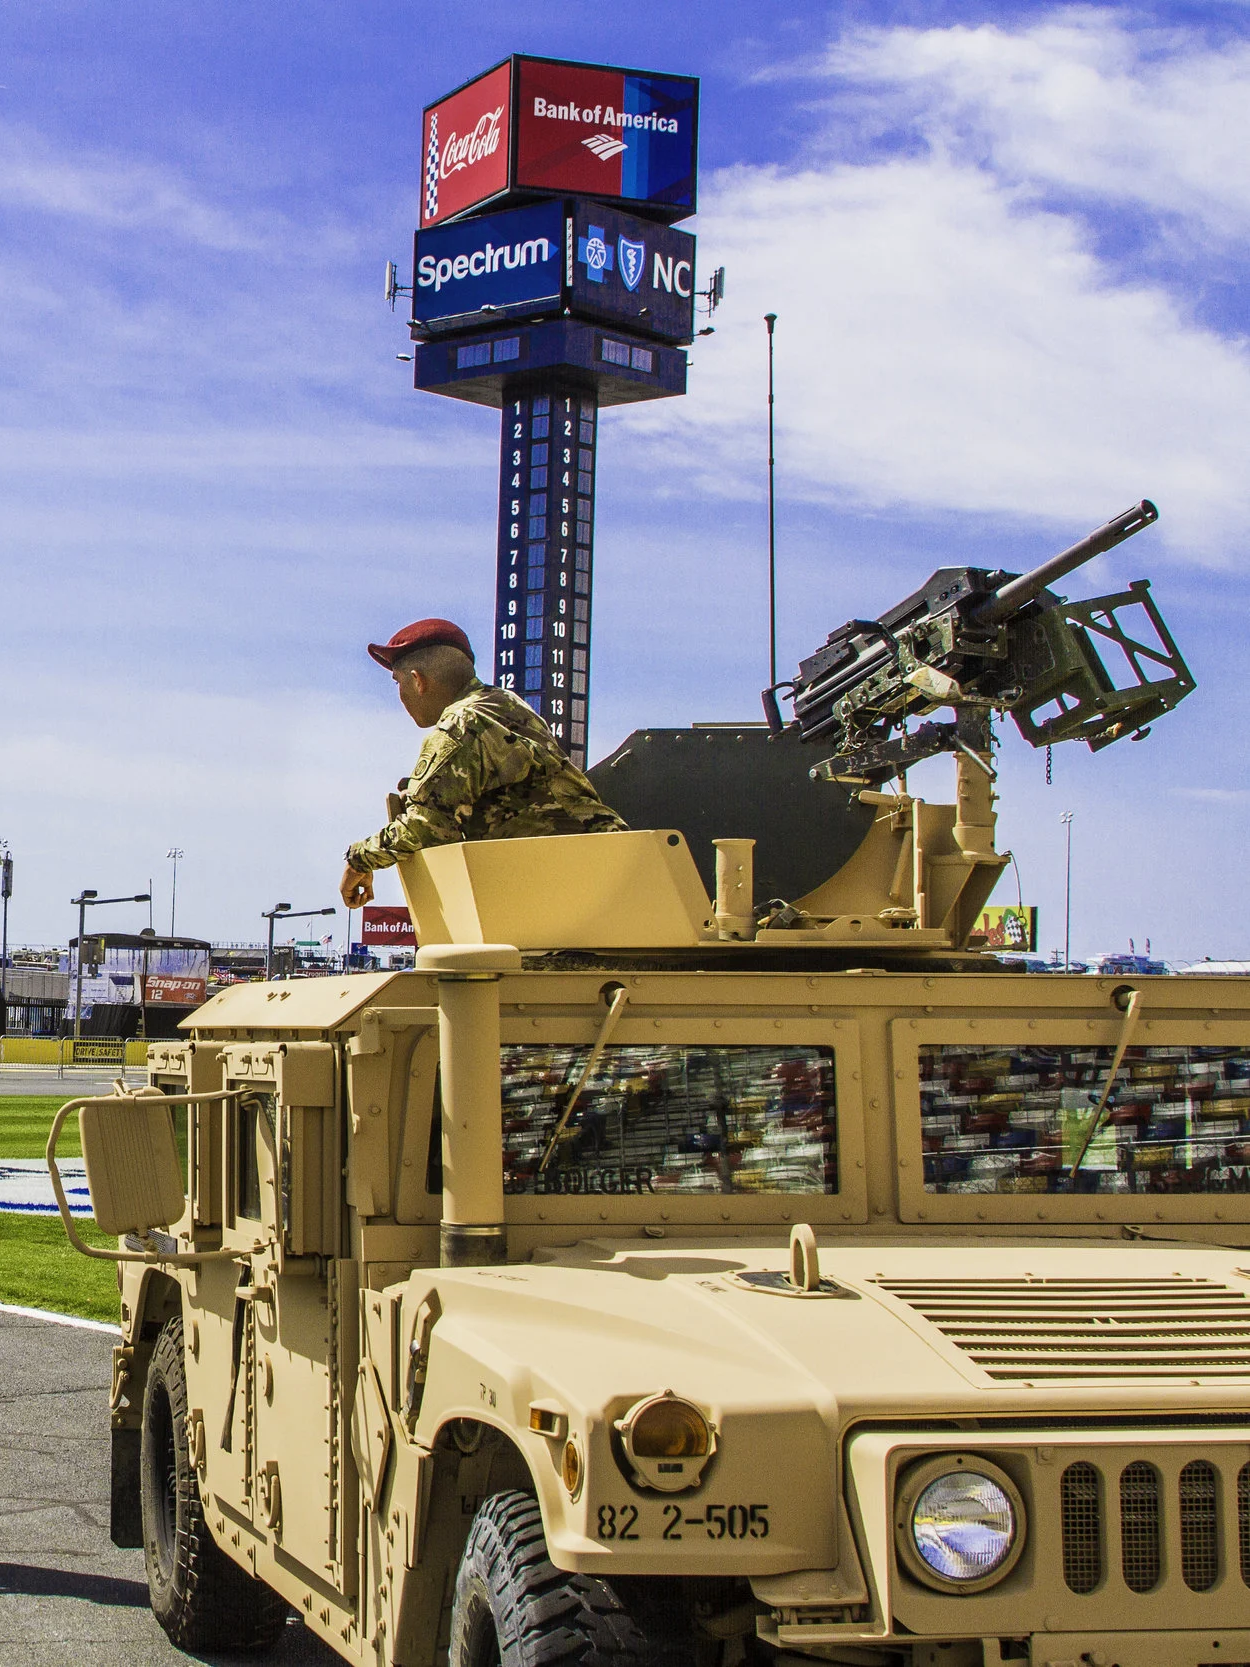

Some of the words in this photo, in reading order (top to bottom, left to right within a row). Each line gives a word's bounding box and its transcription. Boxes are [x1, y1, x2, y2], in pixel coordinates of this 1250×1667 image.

[534, 97, 579, 123] Bank
[582, 103, 601, 124] of
[603, 106, 678, 134] America
[440, 104, 505, 180] Coca-Cola
[417, 237, 549, 292] Spectrum
[652, 252, 691, 298] NC
[514, 400, 520, 415] 1
[565, 398, 570, 413] 1
[514, 423, 522, 438] 2
[564, 420, 572, 436] 2
[513, 450, 521, 466] 3
[563, 448, 570, 463] 3
[511, 473, 520, 488] 4
[562, 471, 570, 486] 4
[511, 500, 519, 515] 5
[562, 499, 569, 513] 5
[511, 523, 519, 538] 6
[561, 521, 568, 536] 6
[510, 550, 518, 565] 7
[561, 549, 567, 563] 7
[509, 573, 517, 588] 8
[560, 572, 566, 587] 8
[508, 600, 517, 615] 9
[559, 599, 566, 614] 9
[500, 623, 516, 639] 10
[552, 622, 565, 637] 10
[500, 650, 514, 665] 11
[552, 649, 564, 664] 11
[499, 673, 515, 689] 12
[552, 672, 564, 688] 12
[551, 699, 563, 715] 13
[550, 722, 563, 738] 14
[364, 921, 389, 932] Bank
[390, 922, 400, 932] of
[146, 976, 200, 990] Snap-on
[151, 989, 163, 1000] 12
[597, 1505, 639, 1540] 82
[663, 1504, 769, 1540] 2-505
